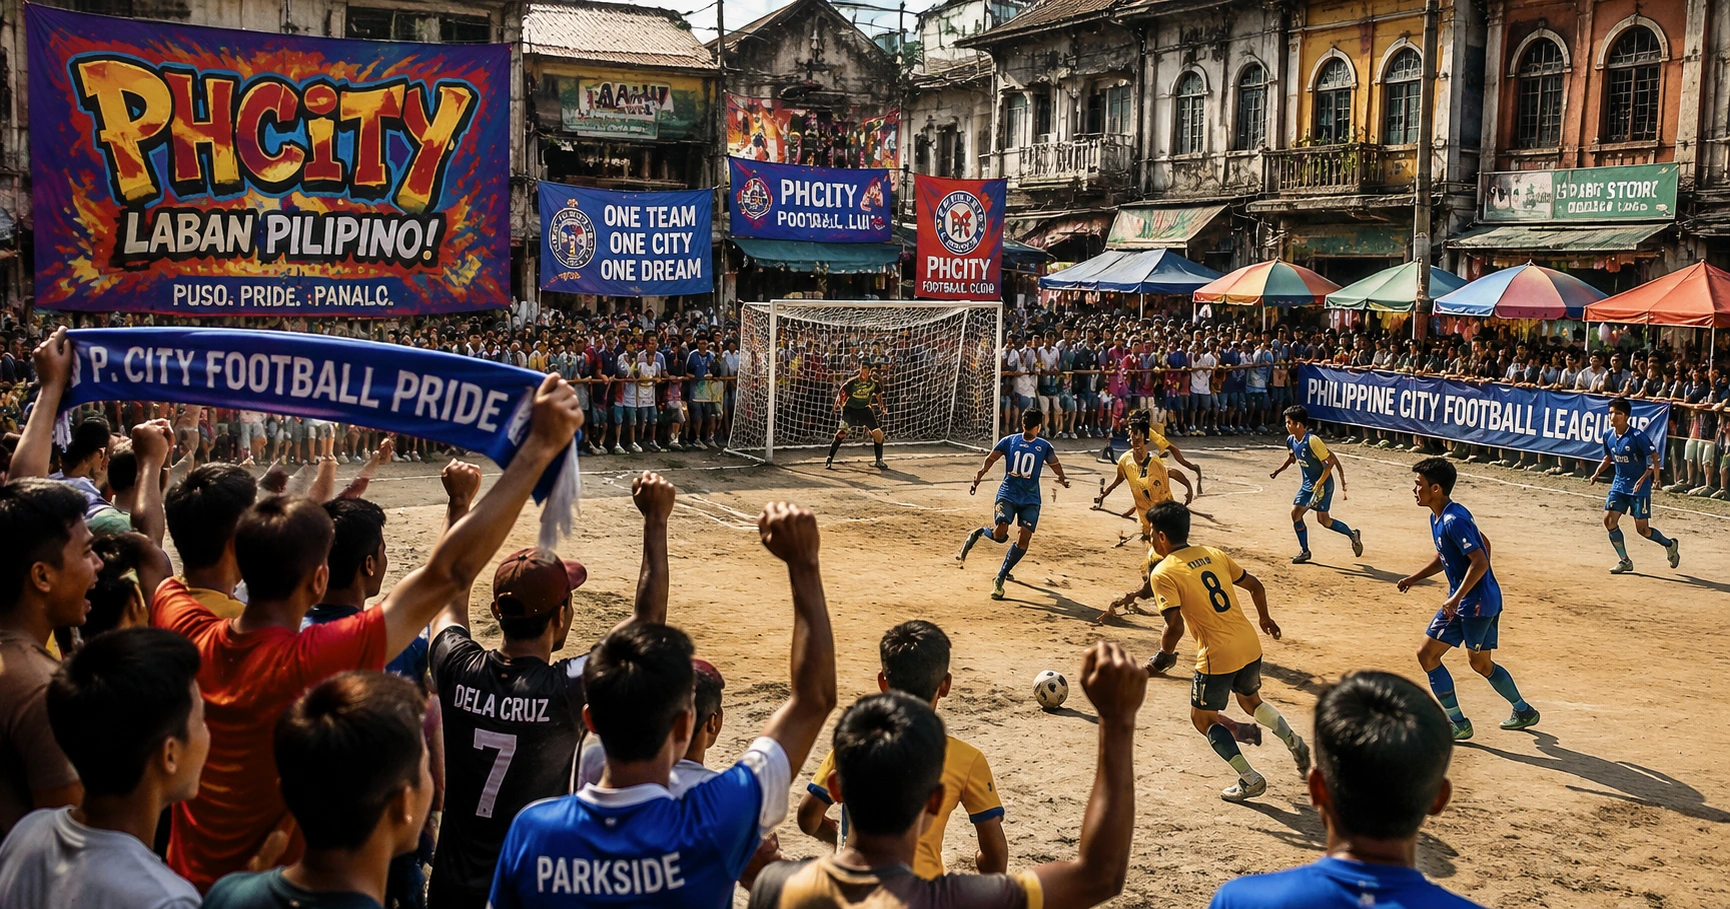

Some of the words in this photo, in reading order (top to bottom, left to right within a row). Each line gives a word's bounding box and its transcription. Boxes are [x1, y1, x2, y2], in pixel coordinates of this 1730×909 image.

[781, 178, 857, 208] PHCITY
[604, 205, 641, 228] ONE
[646, 205, 696, 228] TEAM
[124, 212, 254, 254] LABAN
[266, 213, 440, 261] PILIPINO!
[610, 232, 646, 254] ONE
[652, 232, 693, 254] CITY
[601, 259, 636, 281] ONE
[641, 258, 702, 281] DREAM
[927, 255, 991, 280] PHCITY
[124, 346, 195, 386] CITY
[205, 351, 379, 408] FOOTBALL
[391, 370, 509, 433] PRIDE
[1307, 378, 1396, 416] PHILIPPINE
[1400, 390, 1440, 422] CITY
[1443, 395, 1537, 436] FOOTBALL
[1012, 450, 1036, 479] 10
[1201, 570, 1231, 613] 8
[454, 684, 495, 718] DELA
[500, 697, 550, 722] CRUZ
[473, 727, 517, 818] 7
[537, 851, 685, 895] PARKSIDE
